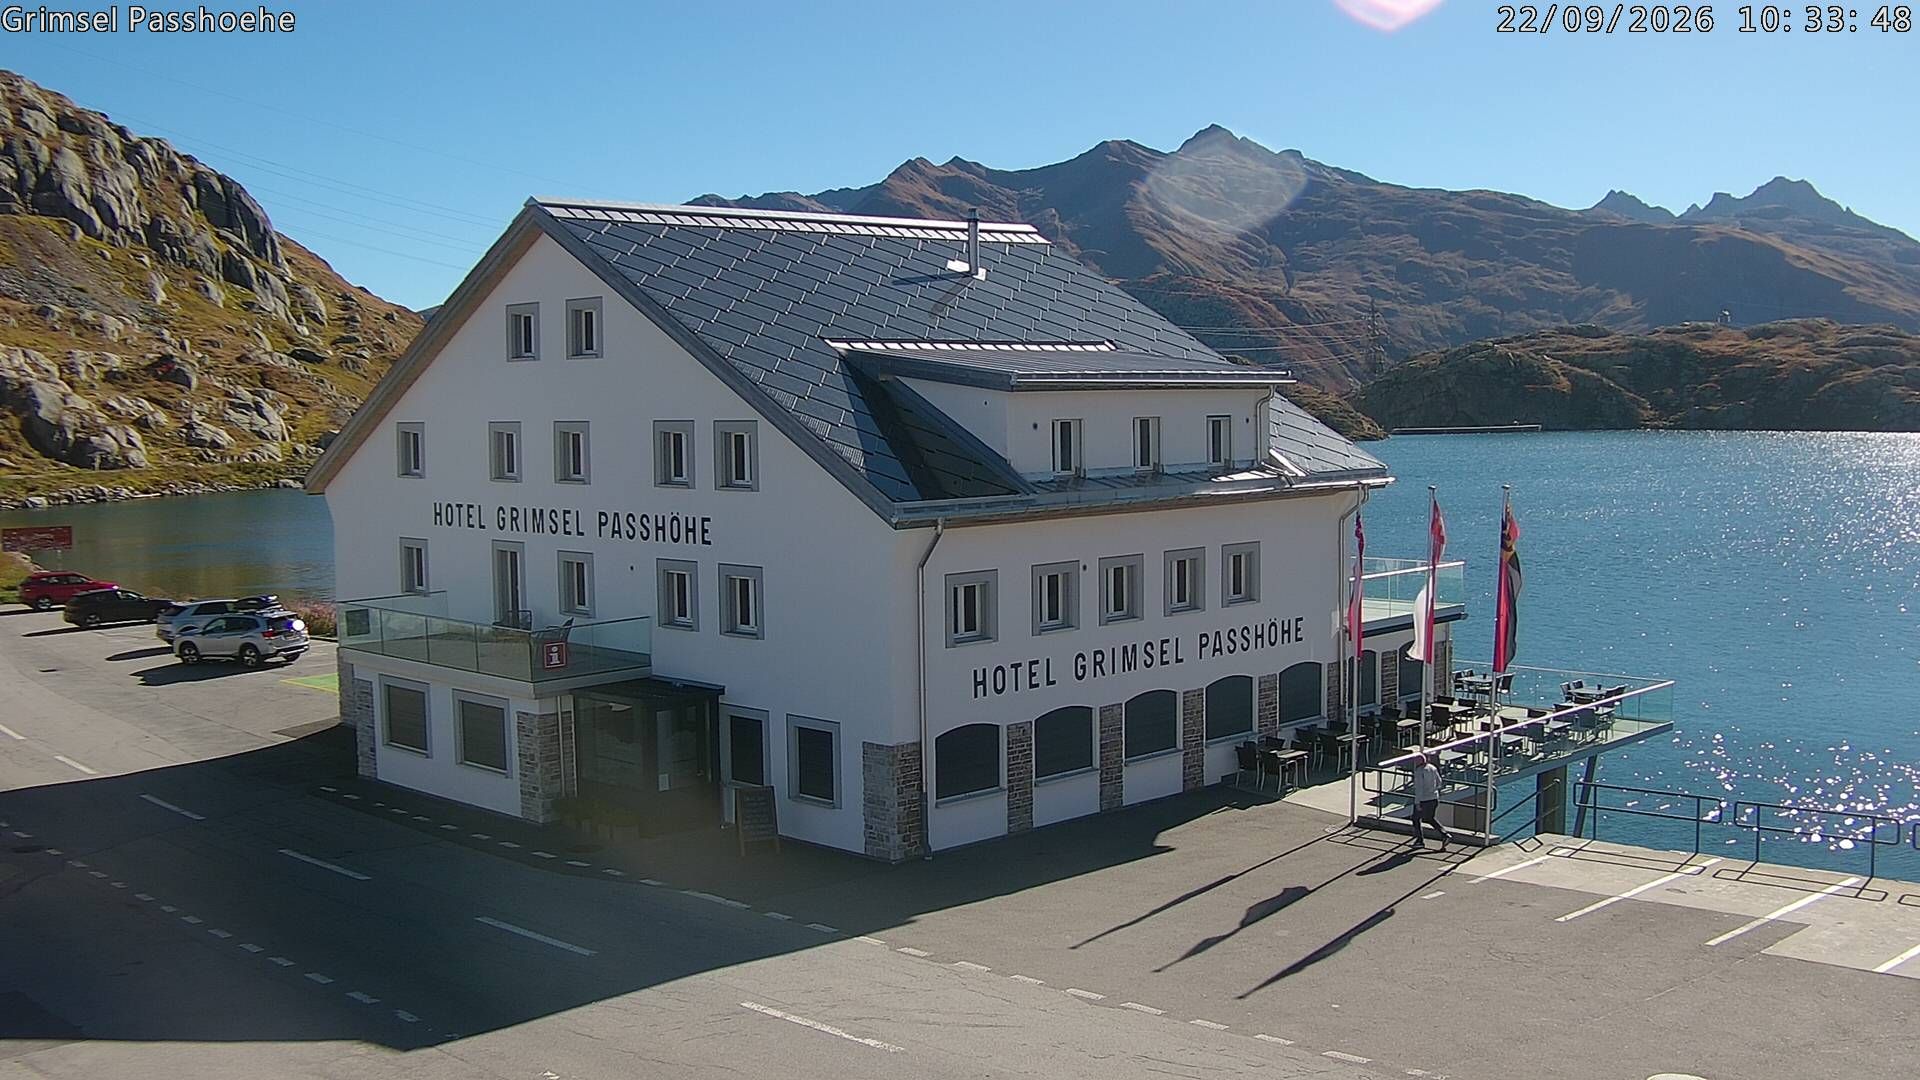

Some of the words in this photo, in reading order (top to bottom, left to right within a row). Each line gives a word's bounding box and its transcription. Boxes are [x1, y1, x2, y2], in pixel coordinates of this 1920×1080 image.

[433, 502, 486, 530] HOTEL
[496, 505, 585, 537] GRIMSEL
[598, 511, 713, 546] PASSHÖHE
[972, 657, 1057, 699] HOTEL
[1073, 636, 1184, 681] GRIMSEL
[1198, 616, 1305, 660] PASSHÖHE
